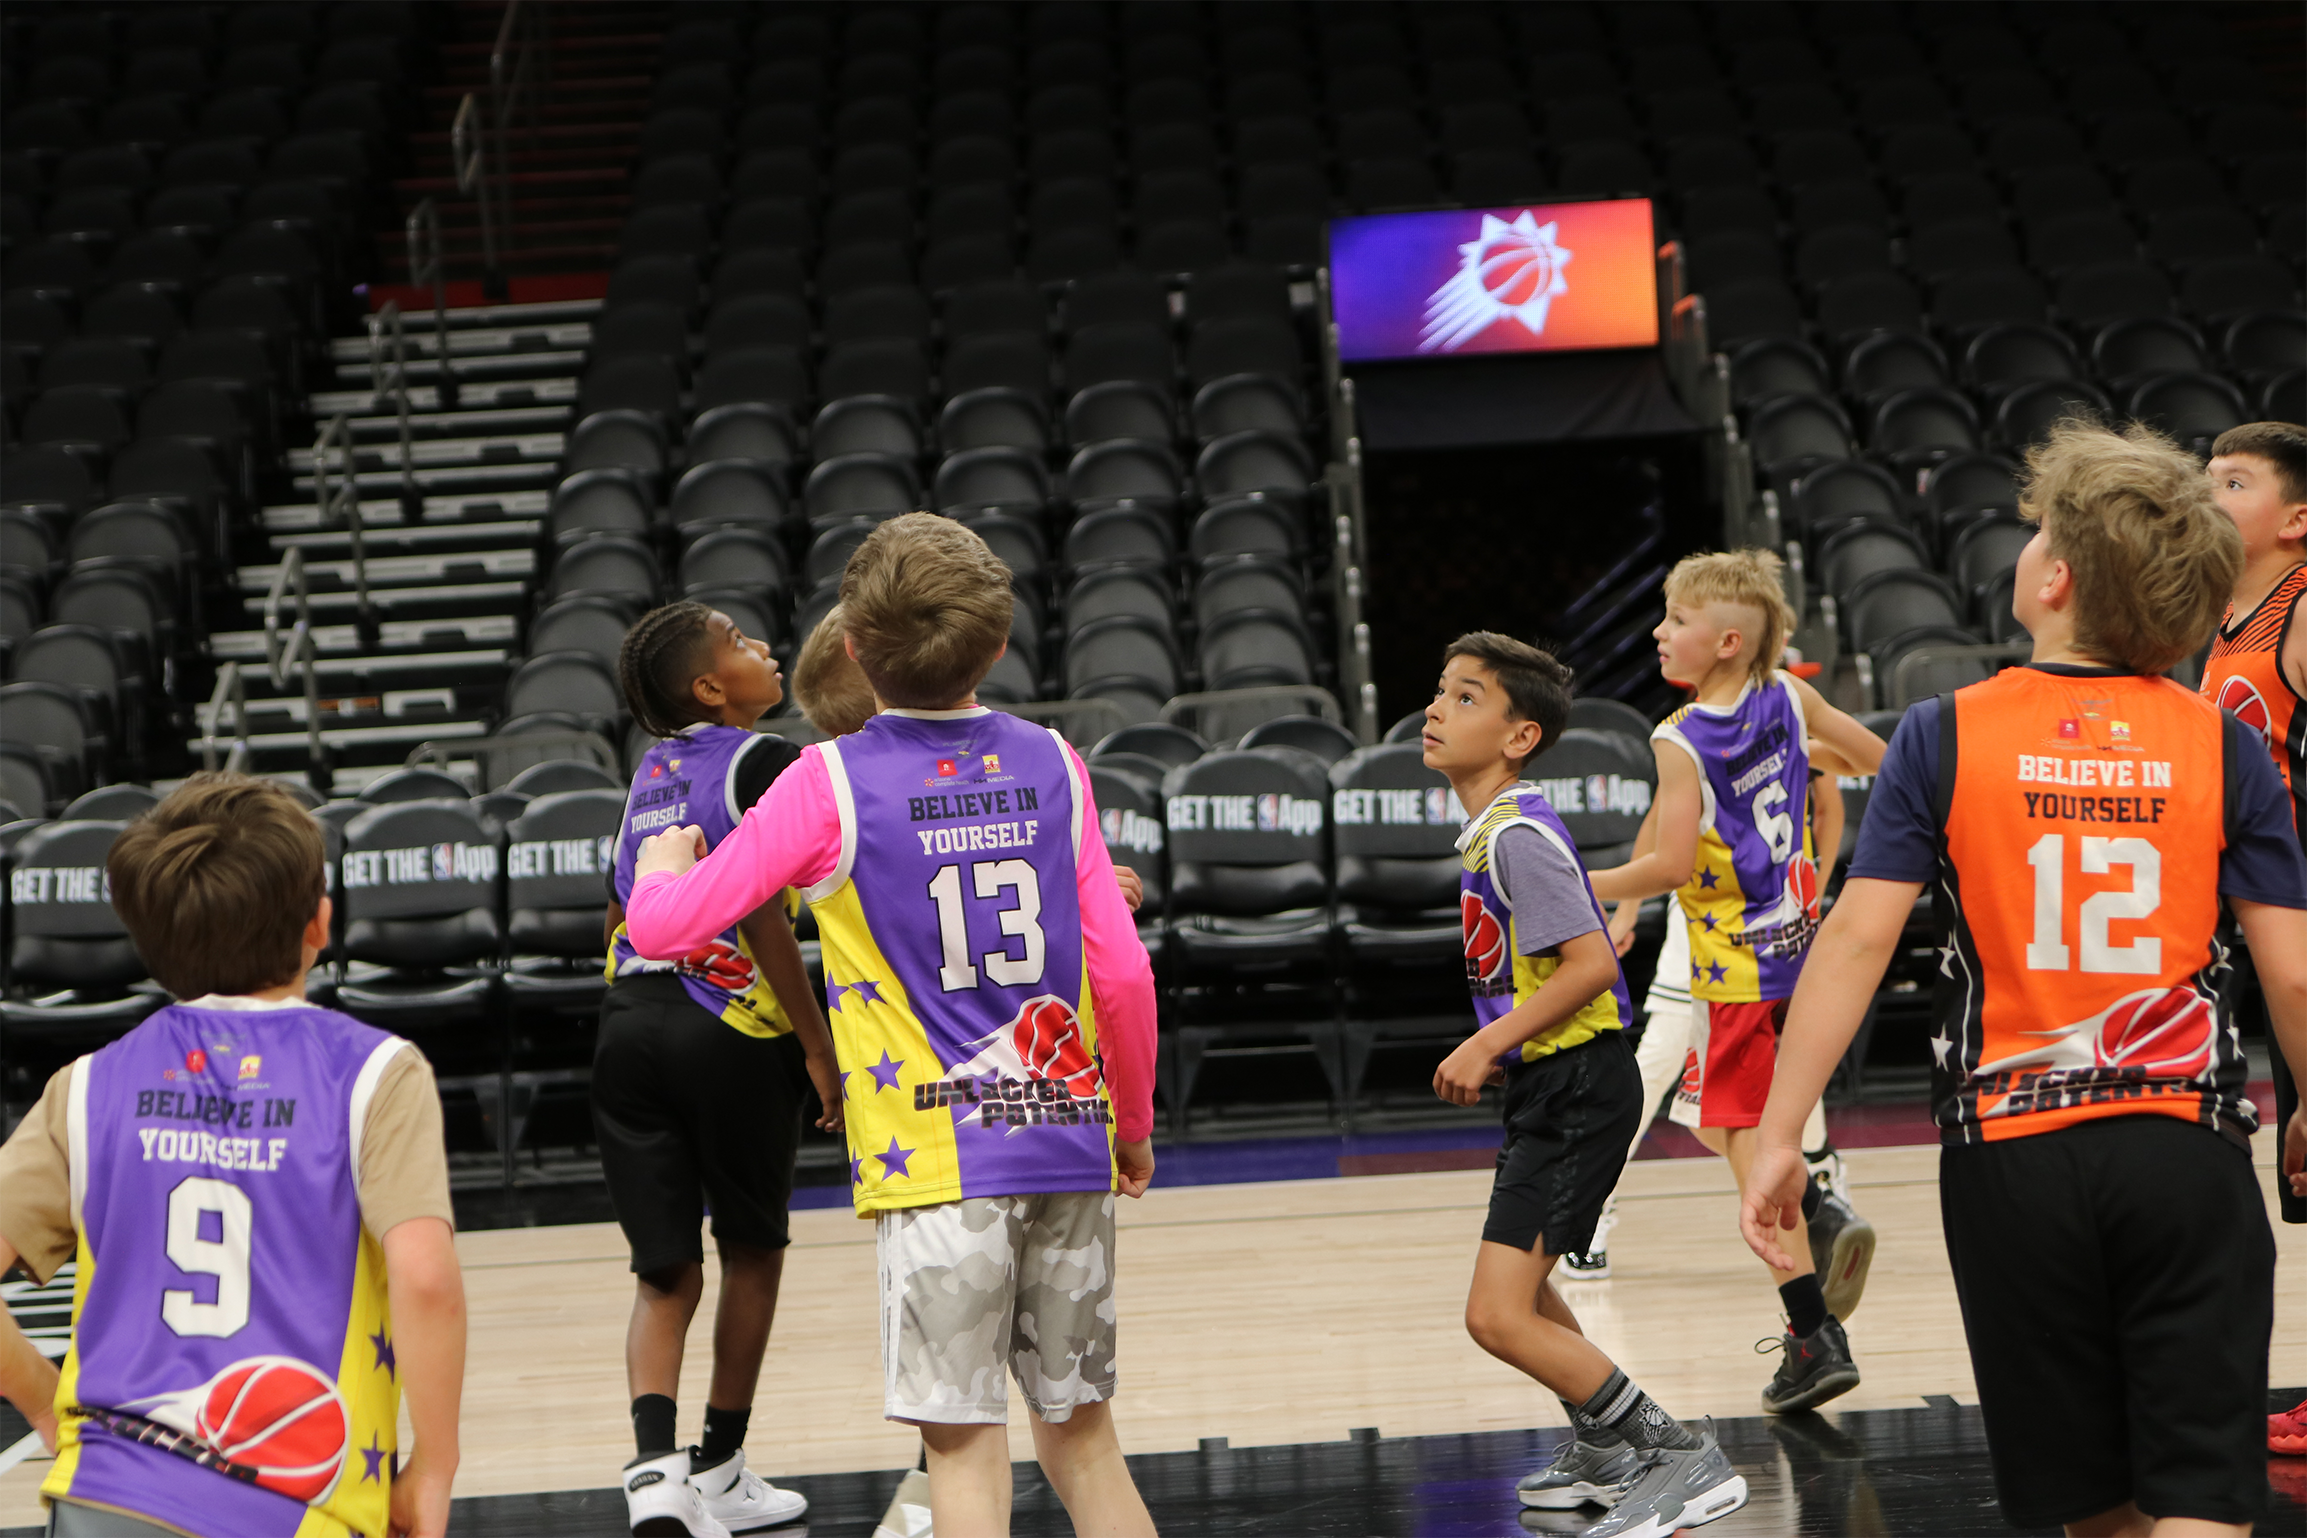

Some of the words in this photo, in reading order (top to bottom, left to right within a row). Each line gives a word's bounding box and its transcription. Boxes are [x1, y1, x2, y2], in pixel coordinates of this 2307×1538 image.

[2018, 754, 2135, 787] BELIEVE
[2142, 760, 2172, 788] IN
[632, 784, 677, 812] BELIEVE
[678, 779, 692, 799] IN
[907, 789, 1010, 821] BELIEVE
[1014, 787, 1039, 812] IN
[1167, 795, 1208, 831] GET
[1210, 795, 1256, 830] THE
[1277, 793, 1323, 837] App
[1333, 789, 1375, 824] GET
[1377, 788, 1423, 824] THE
[1540, 778, 1584, 813] THE
[1607, 773, 1651, 816] App
[2024, 791, 2166, 824] YOURSELF
[631, 802, 687, 834] YOURSELF
[917, 820, 1038, 855] YOURSELF
[1119, 809, 1164, 854] App
[1751, 778, 1794, 865] 6
[342, 851, 382, 889] GET
[384, 847, 431, 884] THE
[454, 841, 498, 884] App
[507, 842, 549, 879] GET
[549, 838, 596, 875] THE
[11, 868, 53, 906] GET
[54, 866, 100, 904] THE
[2026, 833, 2162, 975] 12
[927, 857, 1046, 994] 13
[135, 1090, 254, 1129] BELIEVE
[262, 1098, 297, 1128] IN
[138, 1128, 287, 1171] YOURSELF
[159, 1175, 253, 1340] 9
